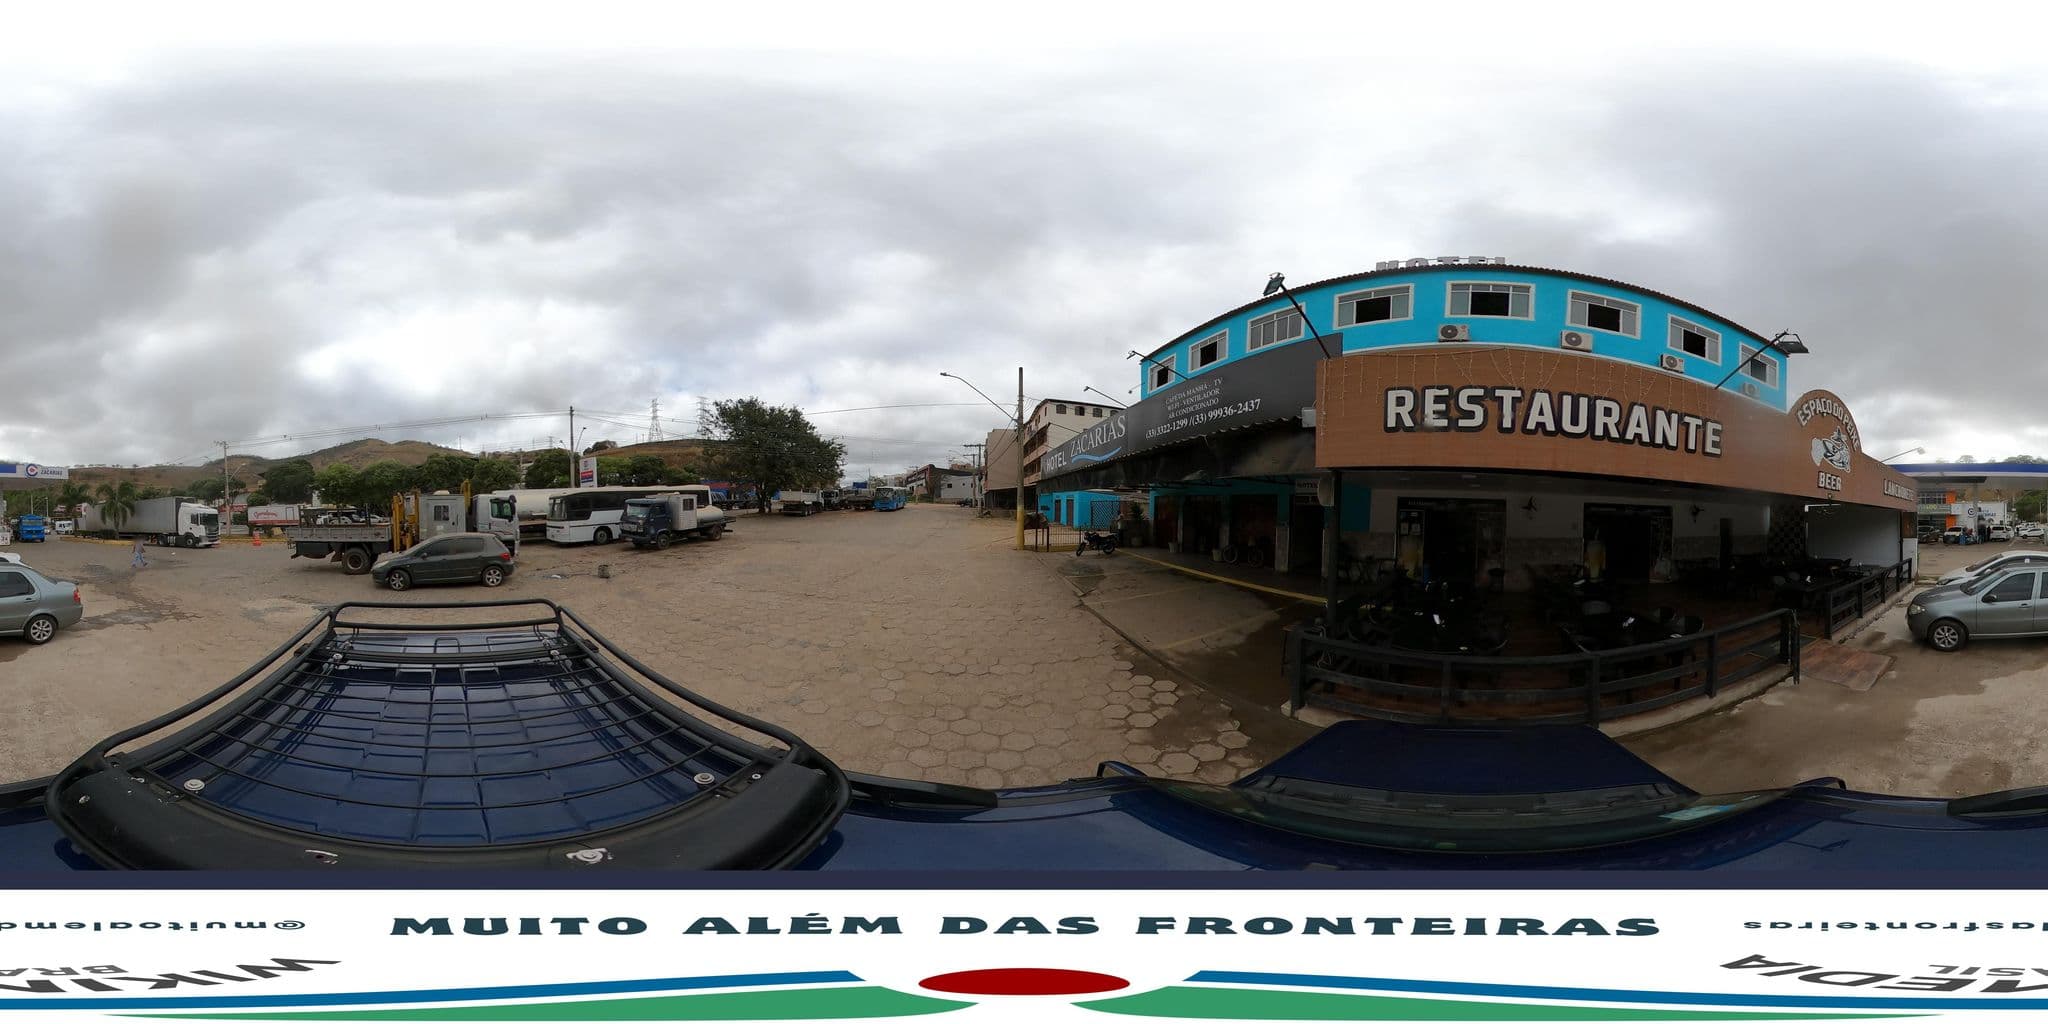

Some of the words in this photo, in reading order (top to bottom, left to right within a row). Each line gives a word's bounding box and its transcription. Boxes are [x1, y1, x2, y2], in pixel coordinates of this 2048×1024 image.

[1175, 398, 1219, 416] CONDICIONADO
[1183, 388, 1220, 405] VENTILADOR
[1207, 398, 1261, 420] 99936-2437
[1385, 387, 1723, 456] RESTAURANTE
[1832, 403, 1844, 420] DO
[1842, 414, 1860, 450] PEIXE
[1046, 451, 1067, 472] HOTEL
[1070, 415, 1126, 457] ZACARIAS
[1818, 471, 1841, 491] BEER
